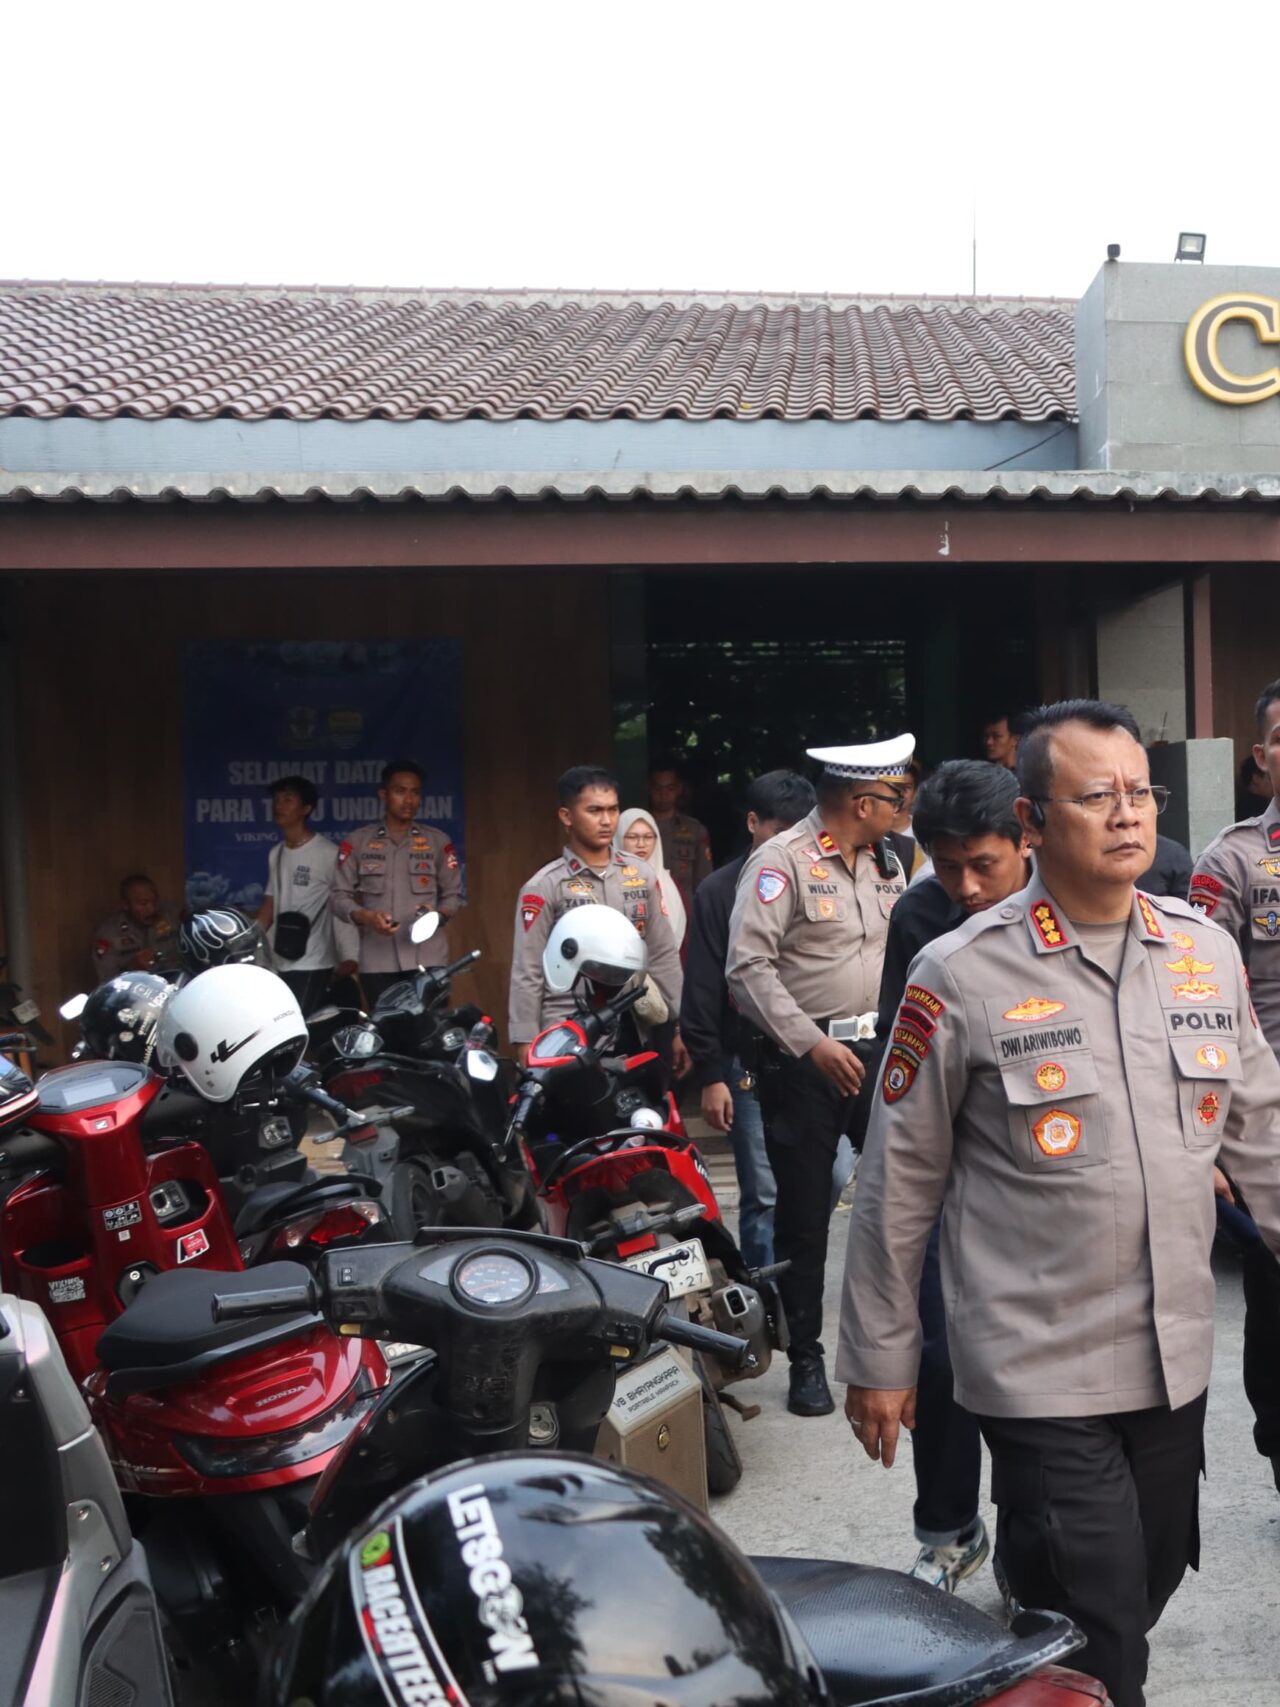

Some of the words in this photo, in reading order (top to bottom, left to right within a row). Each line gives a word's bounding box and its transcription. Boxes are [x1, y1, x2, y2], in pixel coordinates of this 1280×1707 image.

[196, 799, 255, 823] PARA
[265, 797, 324, 822] TU
[808, 883, 839, 895] WILLY
[1170, 1012, 1233, 1032] POLRI
[1001, 1038, 1022, 1059] DWI
[1022, 1027, 1083, 1054] ARIWIBOWO
[254, 1385, 308, 1408] HONDA
[613, 1395, 627, 1409] VB
